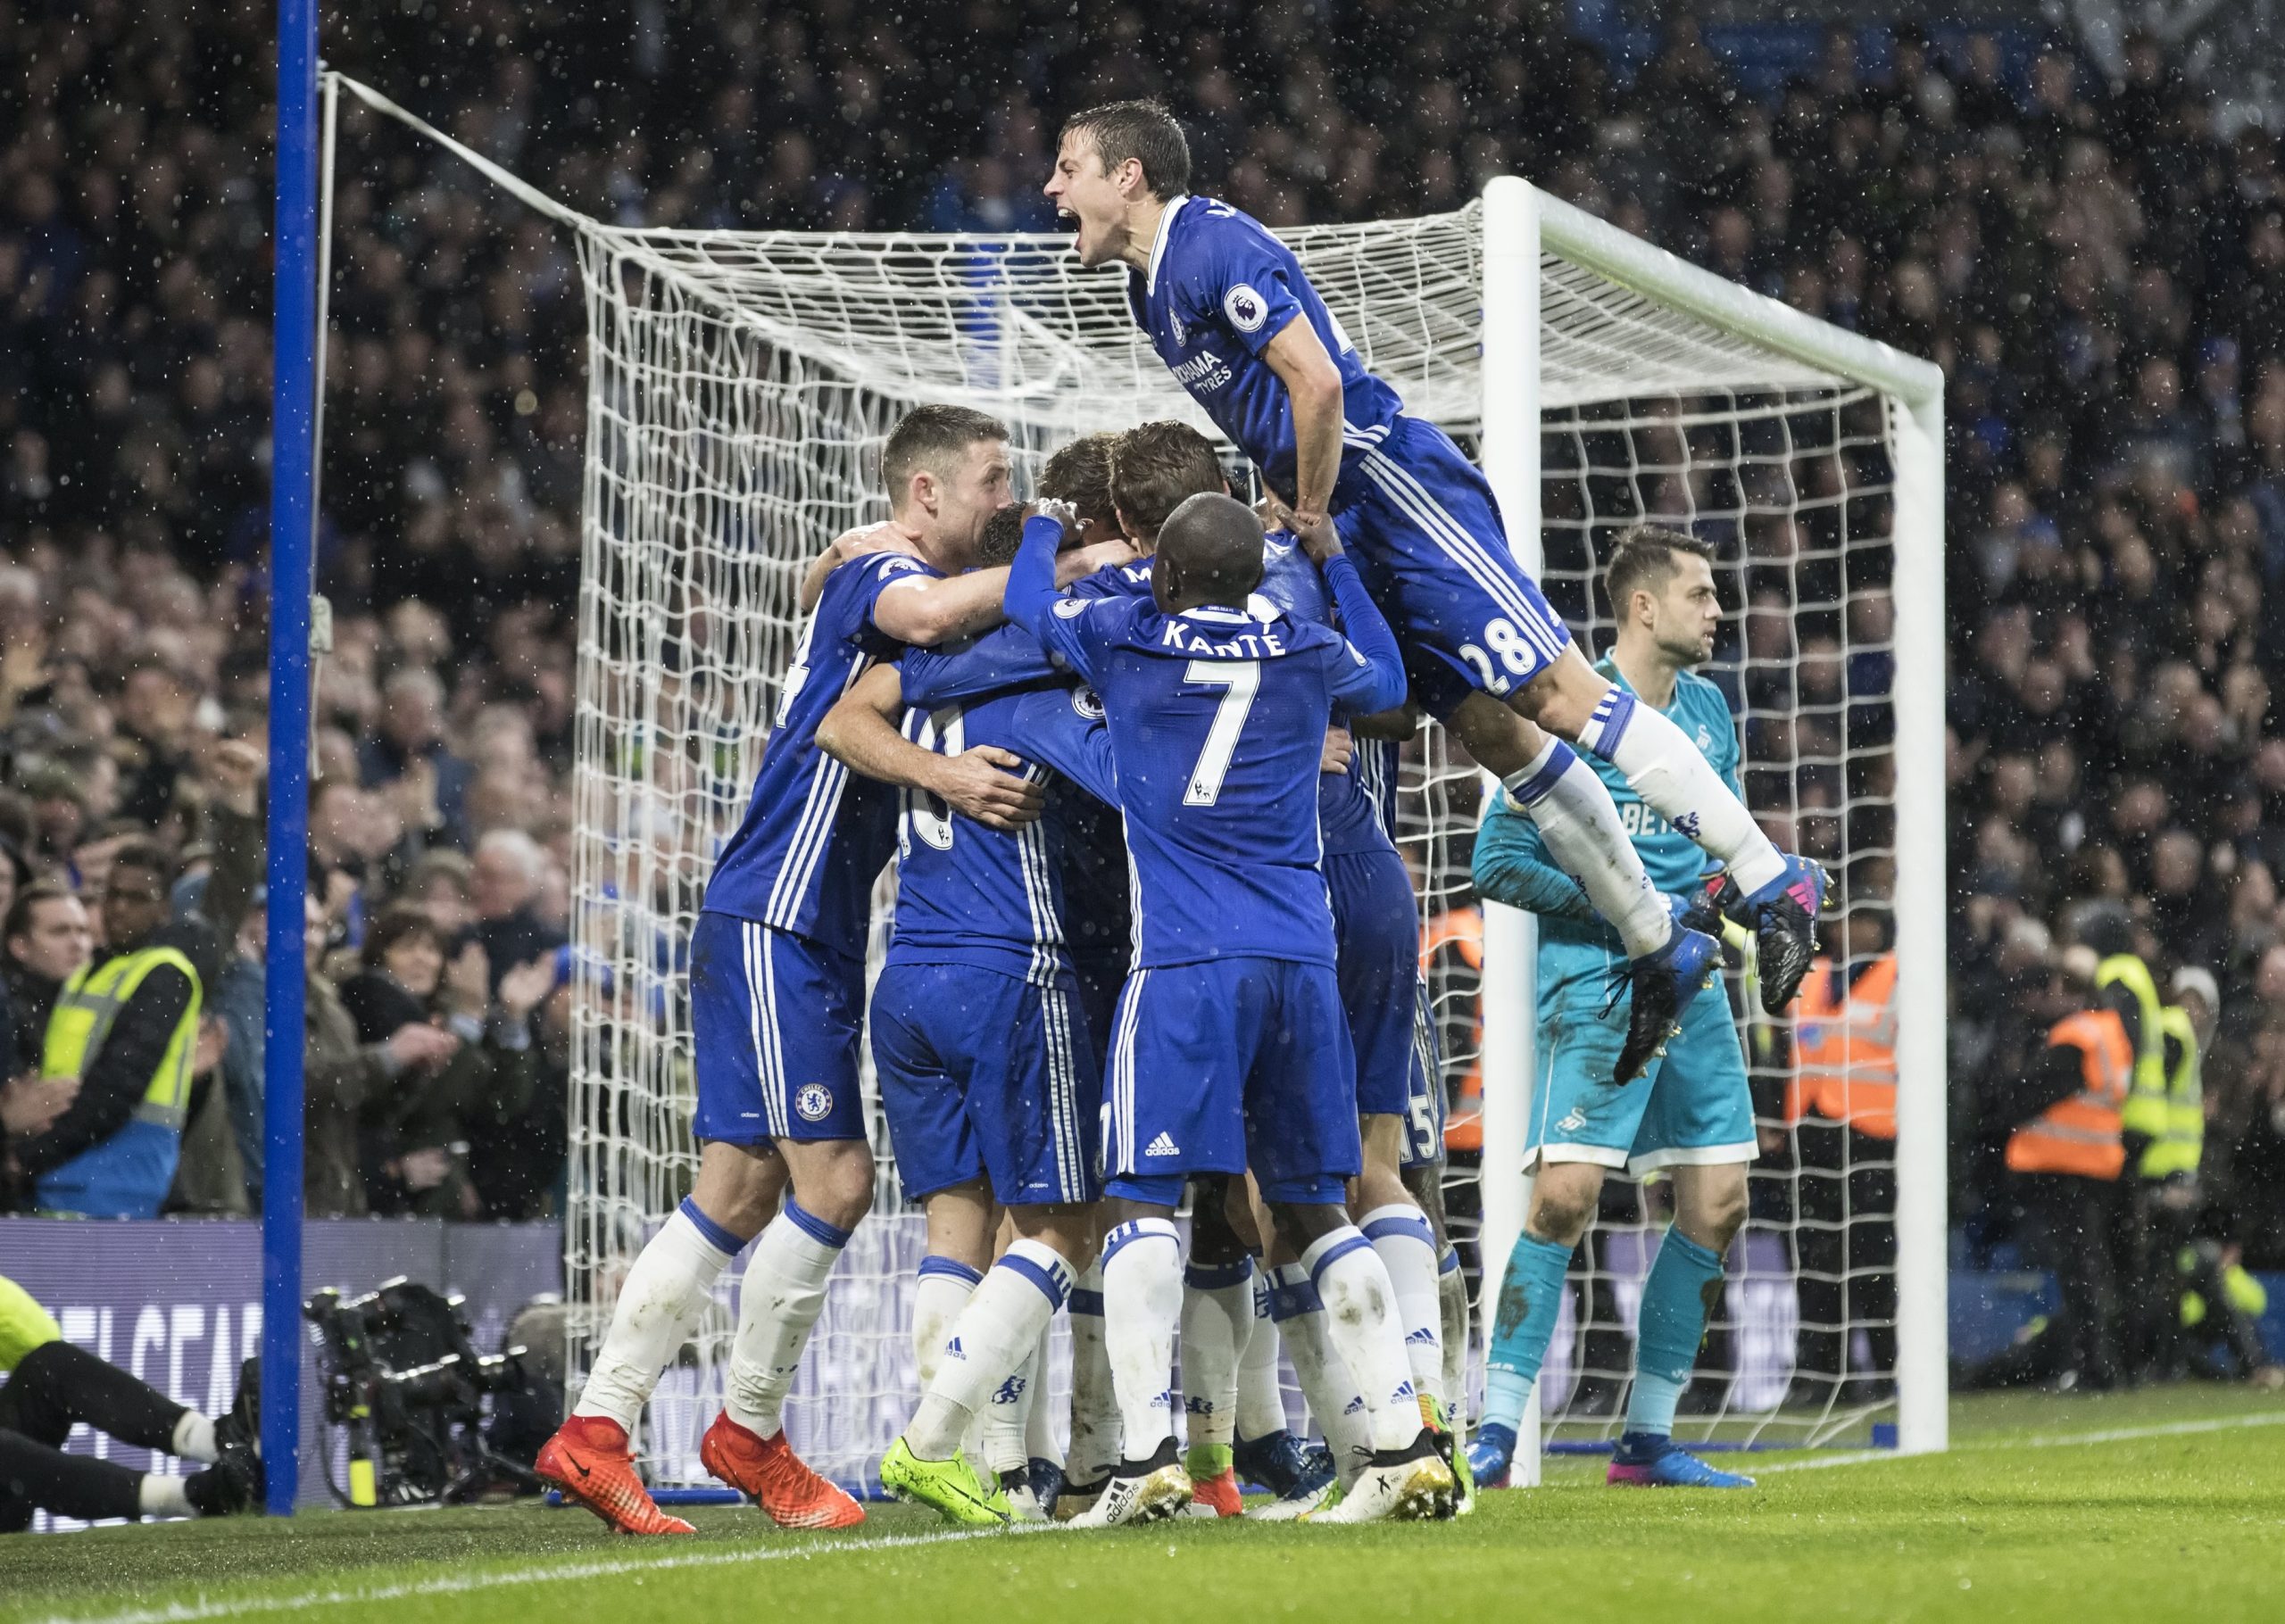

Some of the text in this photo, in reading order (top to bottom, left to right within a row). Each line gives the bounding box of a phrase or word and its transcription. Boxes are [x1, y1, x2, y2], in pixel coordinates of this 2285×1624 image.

[1198, 365, 1232, 394] TYRES
[1162, 620, 1286, 658] KANTÉ
[1458, 617, 1536, 696] 28
[1183, 659, 1261, 807] 7
[1144, 1147, 1181, 1156] adidas
[1107, 1484, 1139, 1523] adidas
